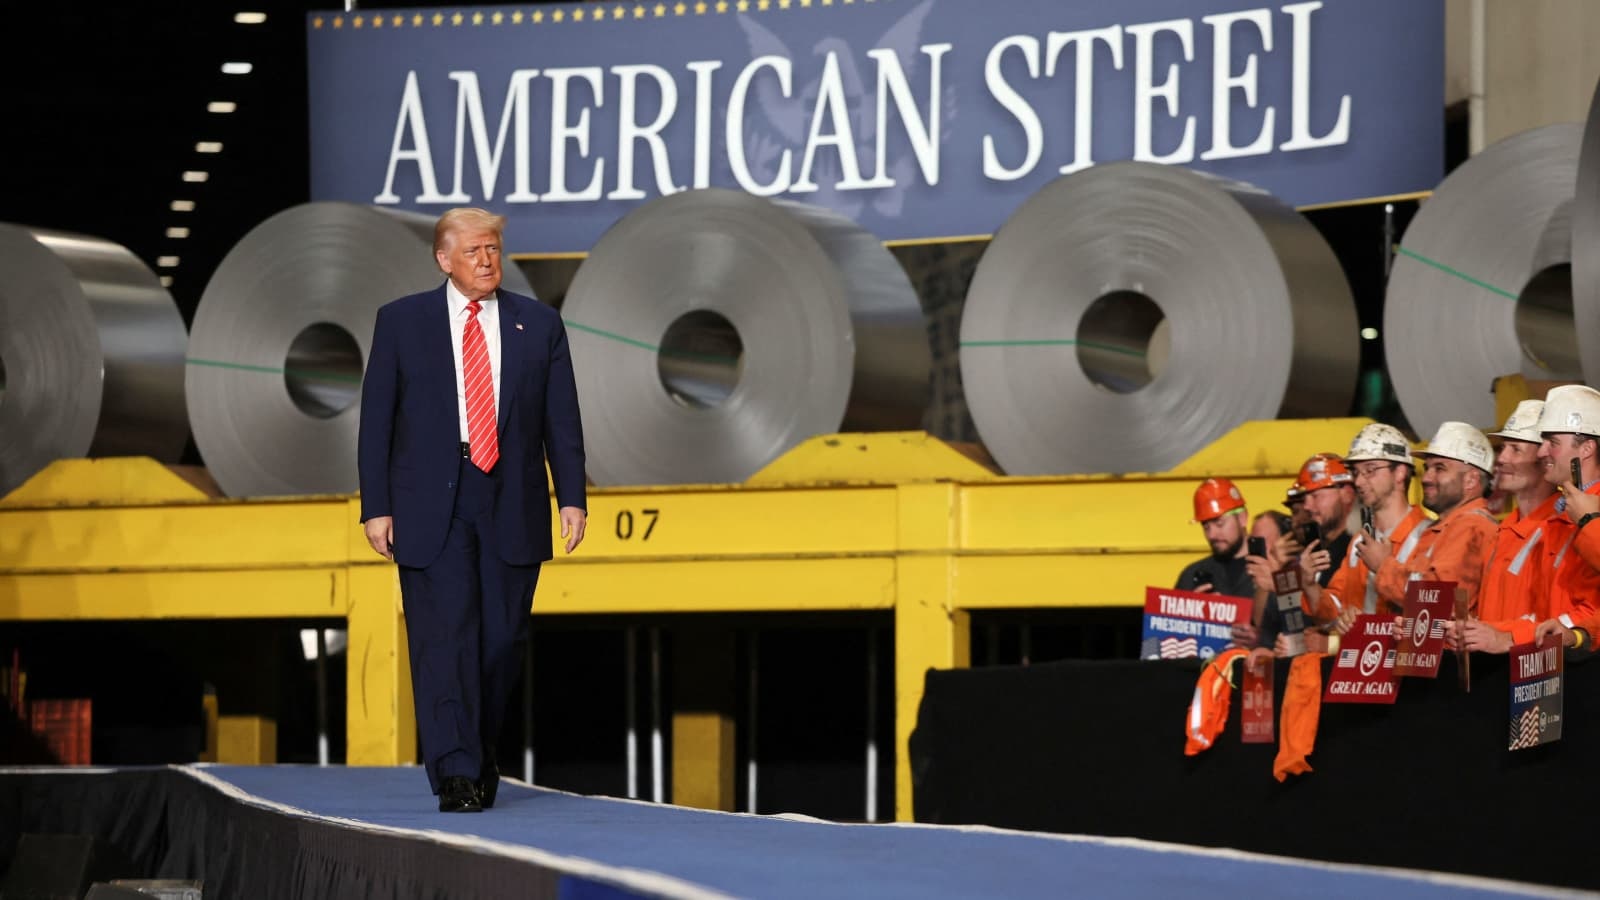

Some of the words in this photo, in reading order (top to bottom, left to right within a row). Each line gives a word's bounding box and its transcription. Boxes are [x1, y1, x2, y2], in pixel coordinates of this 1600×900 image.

[374, 43, 953, 204] AMERICAN
[983, 1, 1352, 181] STEEL
[616, 509, 660, 541] 07
[1417, 589, 1440, 603] MAKE
[1159, 595, 1205, 619] THANK
[1208, 601, 1237, 622] YOU
[1149, 616, 1203, 636] PRESIDENT
[1364, 622, 1394, 636] MAKE
[1415, 653, 1438, 668] AGAIN
[1518, 652, 1544, 678] THANK
[1545, 647, 1557, 672] YOU
[1330, 681, 1364, 694] GREAT
[1361, 681, 1395, 695] AGAIN
[1514, 682, 1543, 704] PRESIDENT
